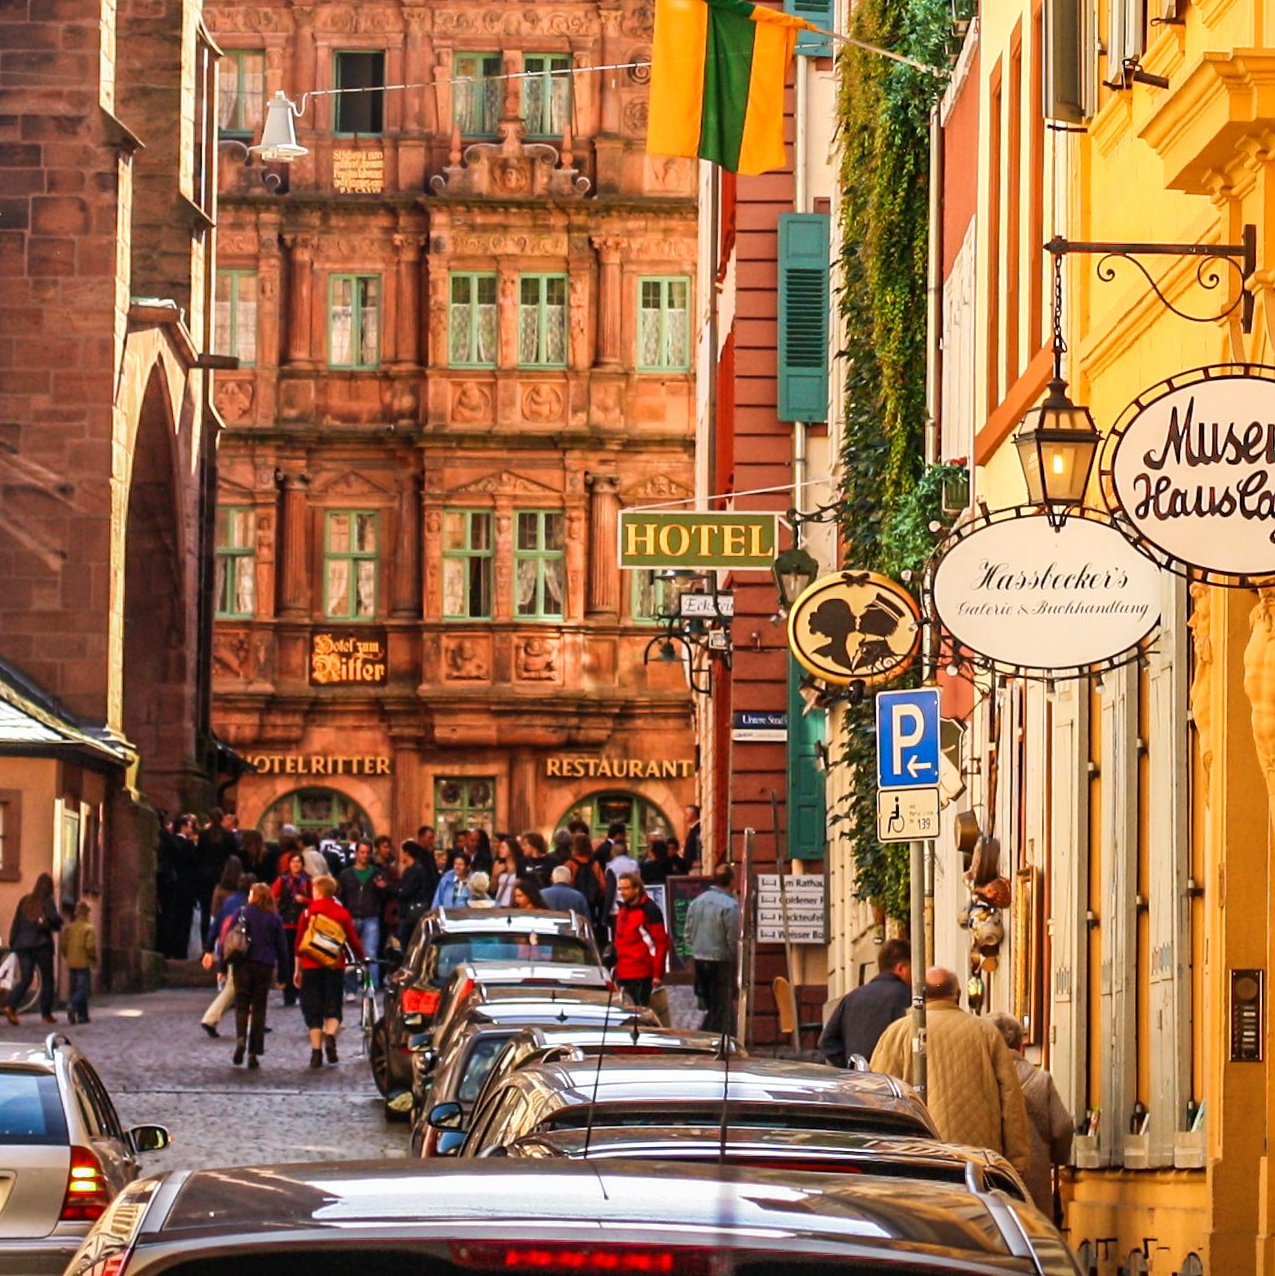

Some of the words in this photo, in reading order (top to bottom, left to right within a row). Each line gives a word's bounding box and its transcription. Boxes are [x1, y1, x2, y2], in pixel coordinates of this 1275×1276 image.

[624, 523, 774, 557] HOTEL
[955, 600, 1013, 617] Galerie
[1031, 599, 1150, 623] Buchhandlung
[891, 703, 925, 776] P
[244, 755, 308, 774] OTEL
[310, 755, 391, 774] RITTER
[546, 758, 693, 778] RESTAURANT
